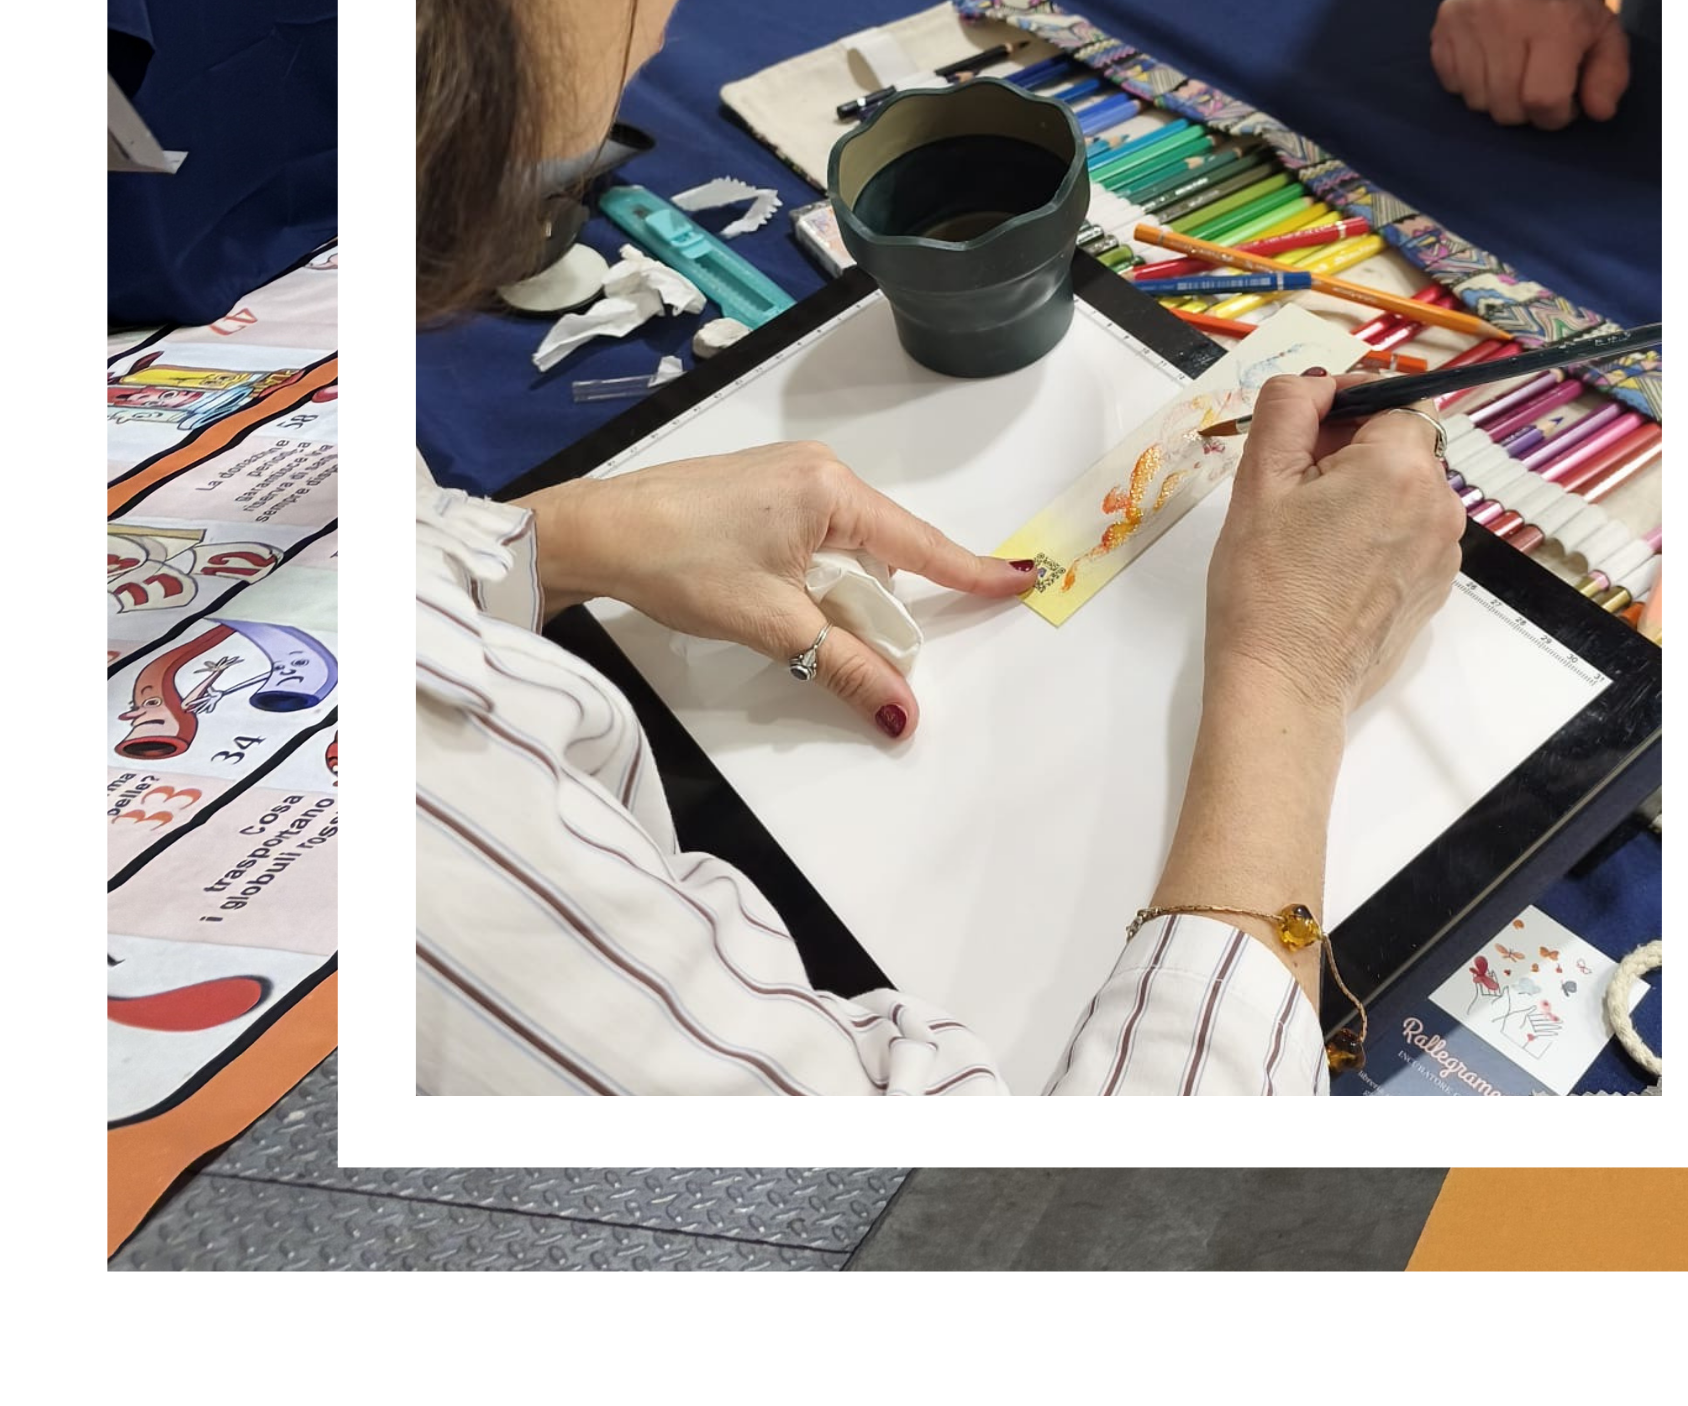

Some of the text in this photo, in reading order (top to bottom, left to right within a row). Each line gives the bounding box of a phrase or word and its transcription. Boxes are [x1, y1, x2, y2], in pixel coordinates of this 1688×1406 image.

[210, 735, 267, 766] 34
[111, 785, 202, 831] 33
[239, 794, 305, 835] Cosa
[203, 798, 335, 893] trasportano
[219, 852, 302, 911] globuli
